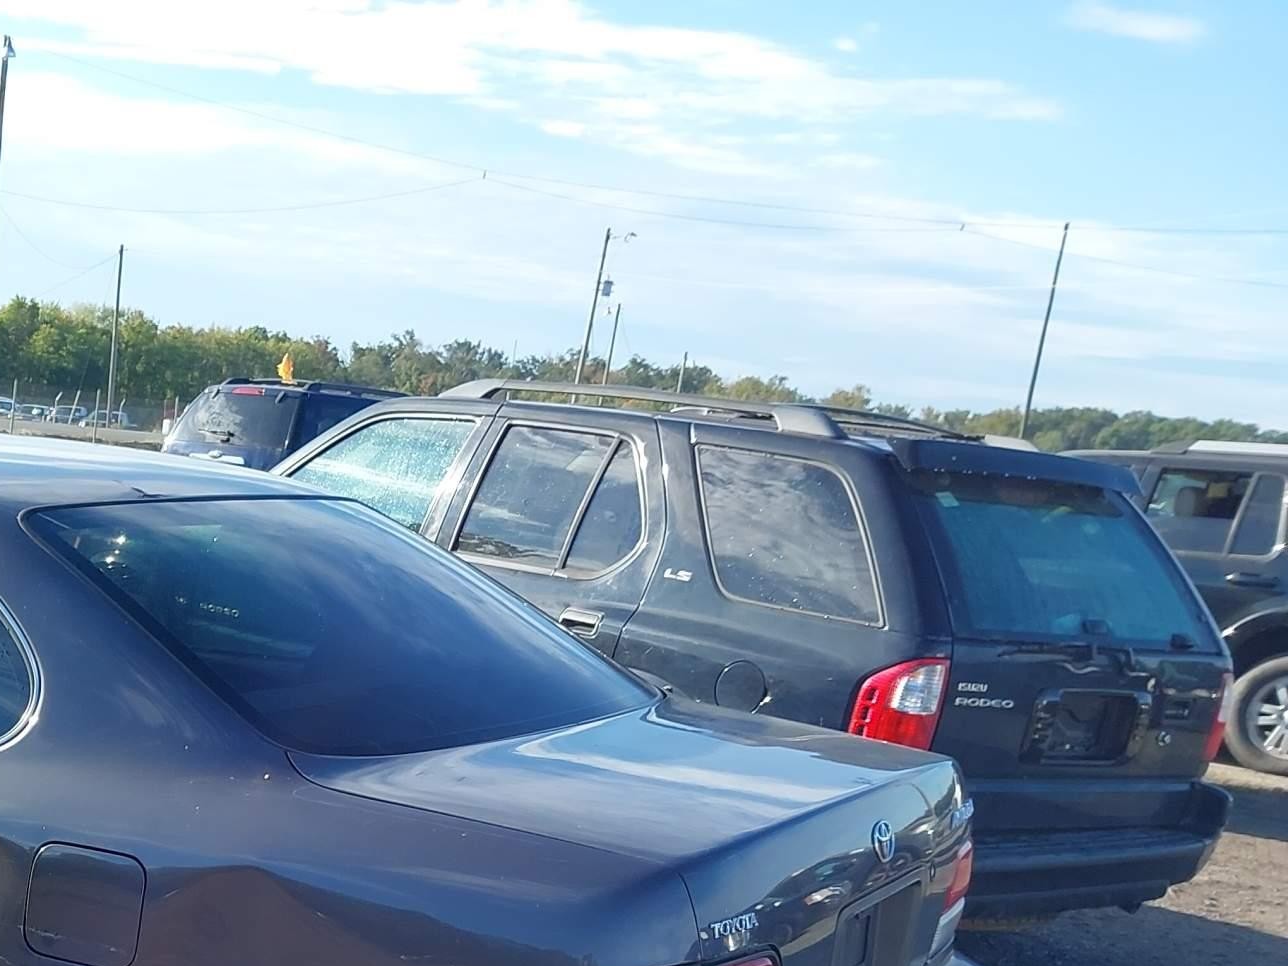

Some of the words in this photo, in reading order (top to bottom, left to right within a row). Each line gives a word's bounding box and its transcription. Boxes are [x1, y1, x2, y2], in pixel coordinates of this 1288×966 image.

[663, 567, 693, 582] LS
[954, 696, 1015, 709] RODEO
[710, 912, 760, 939] TOYOTA
